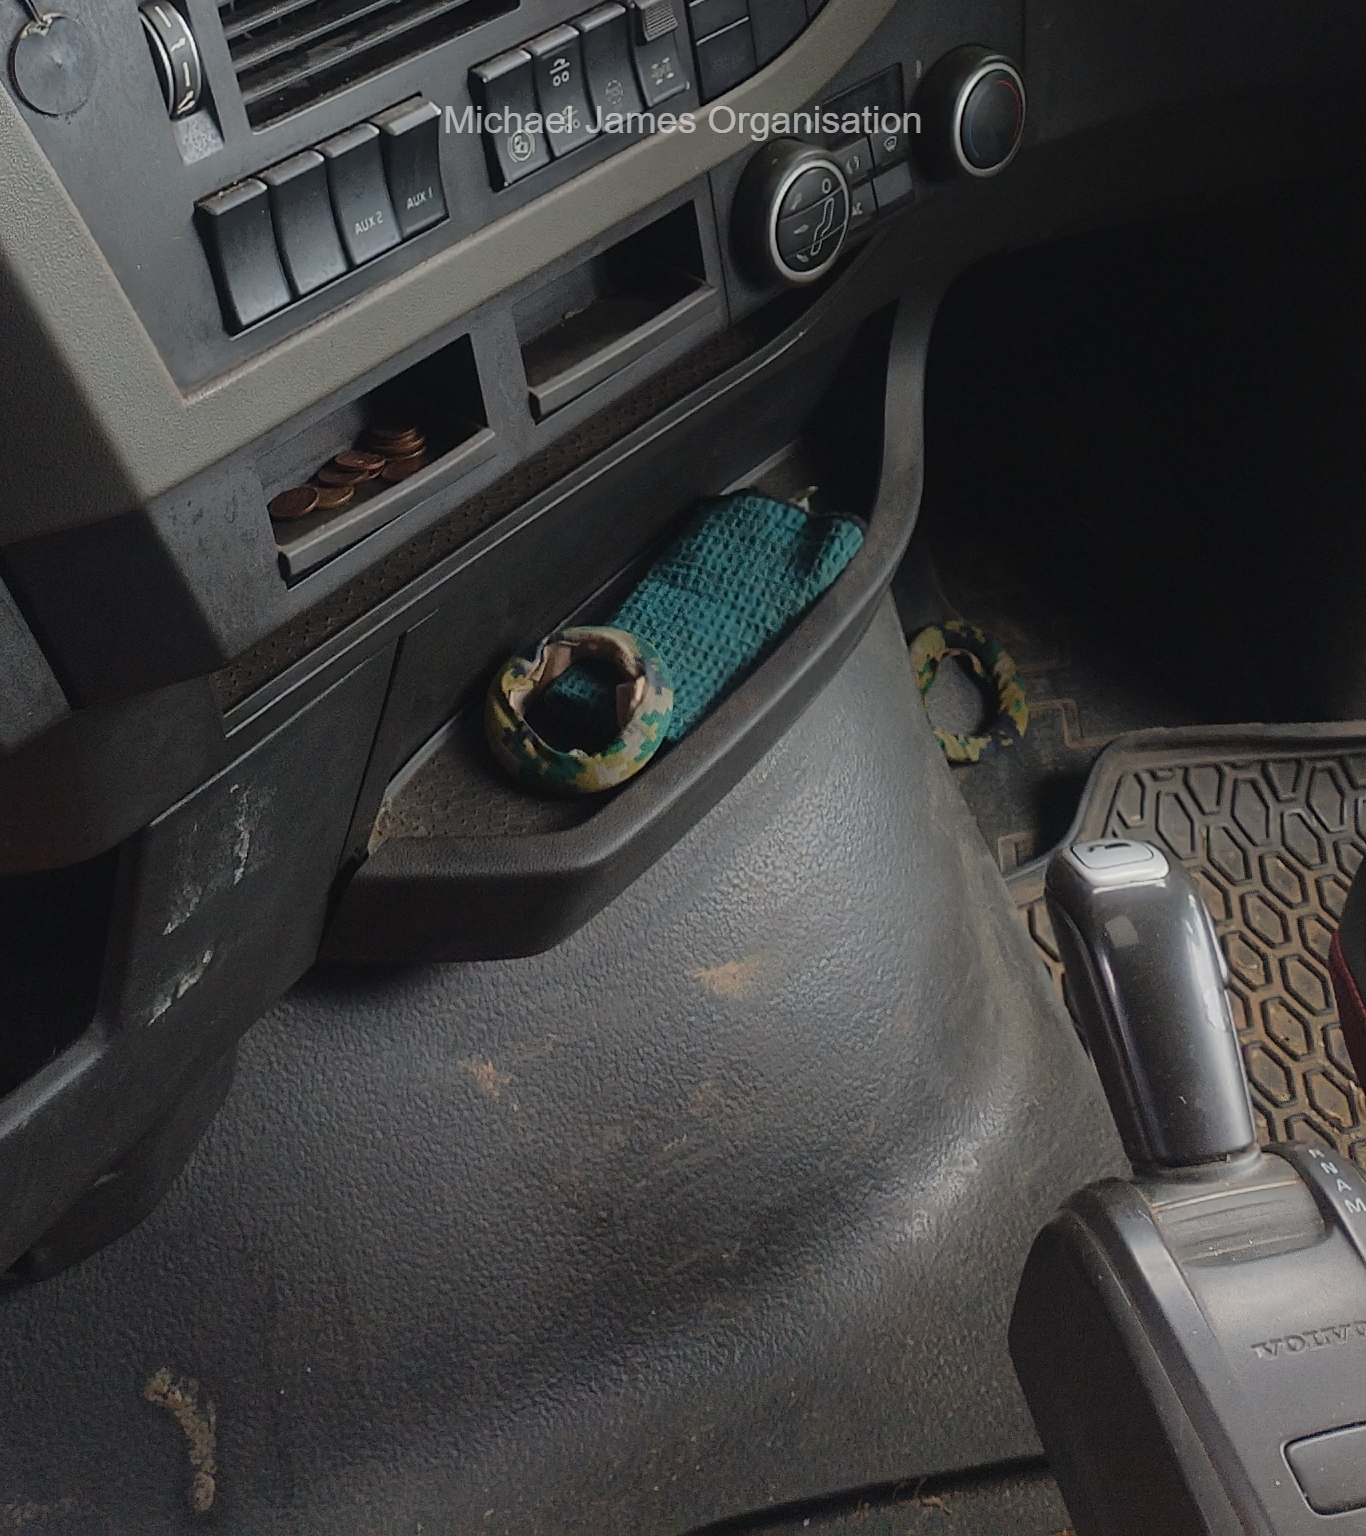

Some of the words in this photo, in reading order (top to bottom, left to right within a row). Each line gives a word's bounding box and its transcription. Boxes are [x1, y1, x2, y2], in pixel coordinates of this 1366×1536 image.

[406, 191, 426, 210] AUX
[428, 186, 434, 199] 1
[355, 216, 376, 235] AUX
[376, 210, 384, 225] 2
[1320, 1161, 1338, 1174] N
[1336, 1178, 1352, 1193] A
